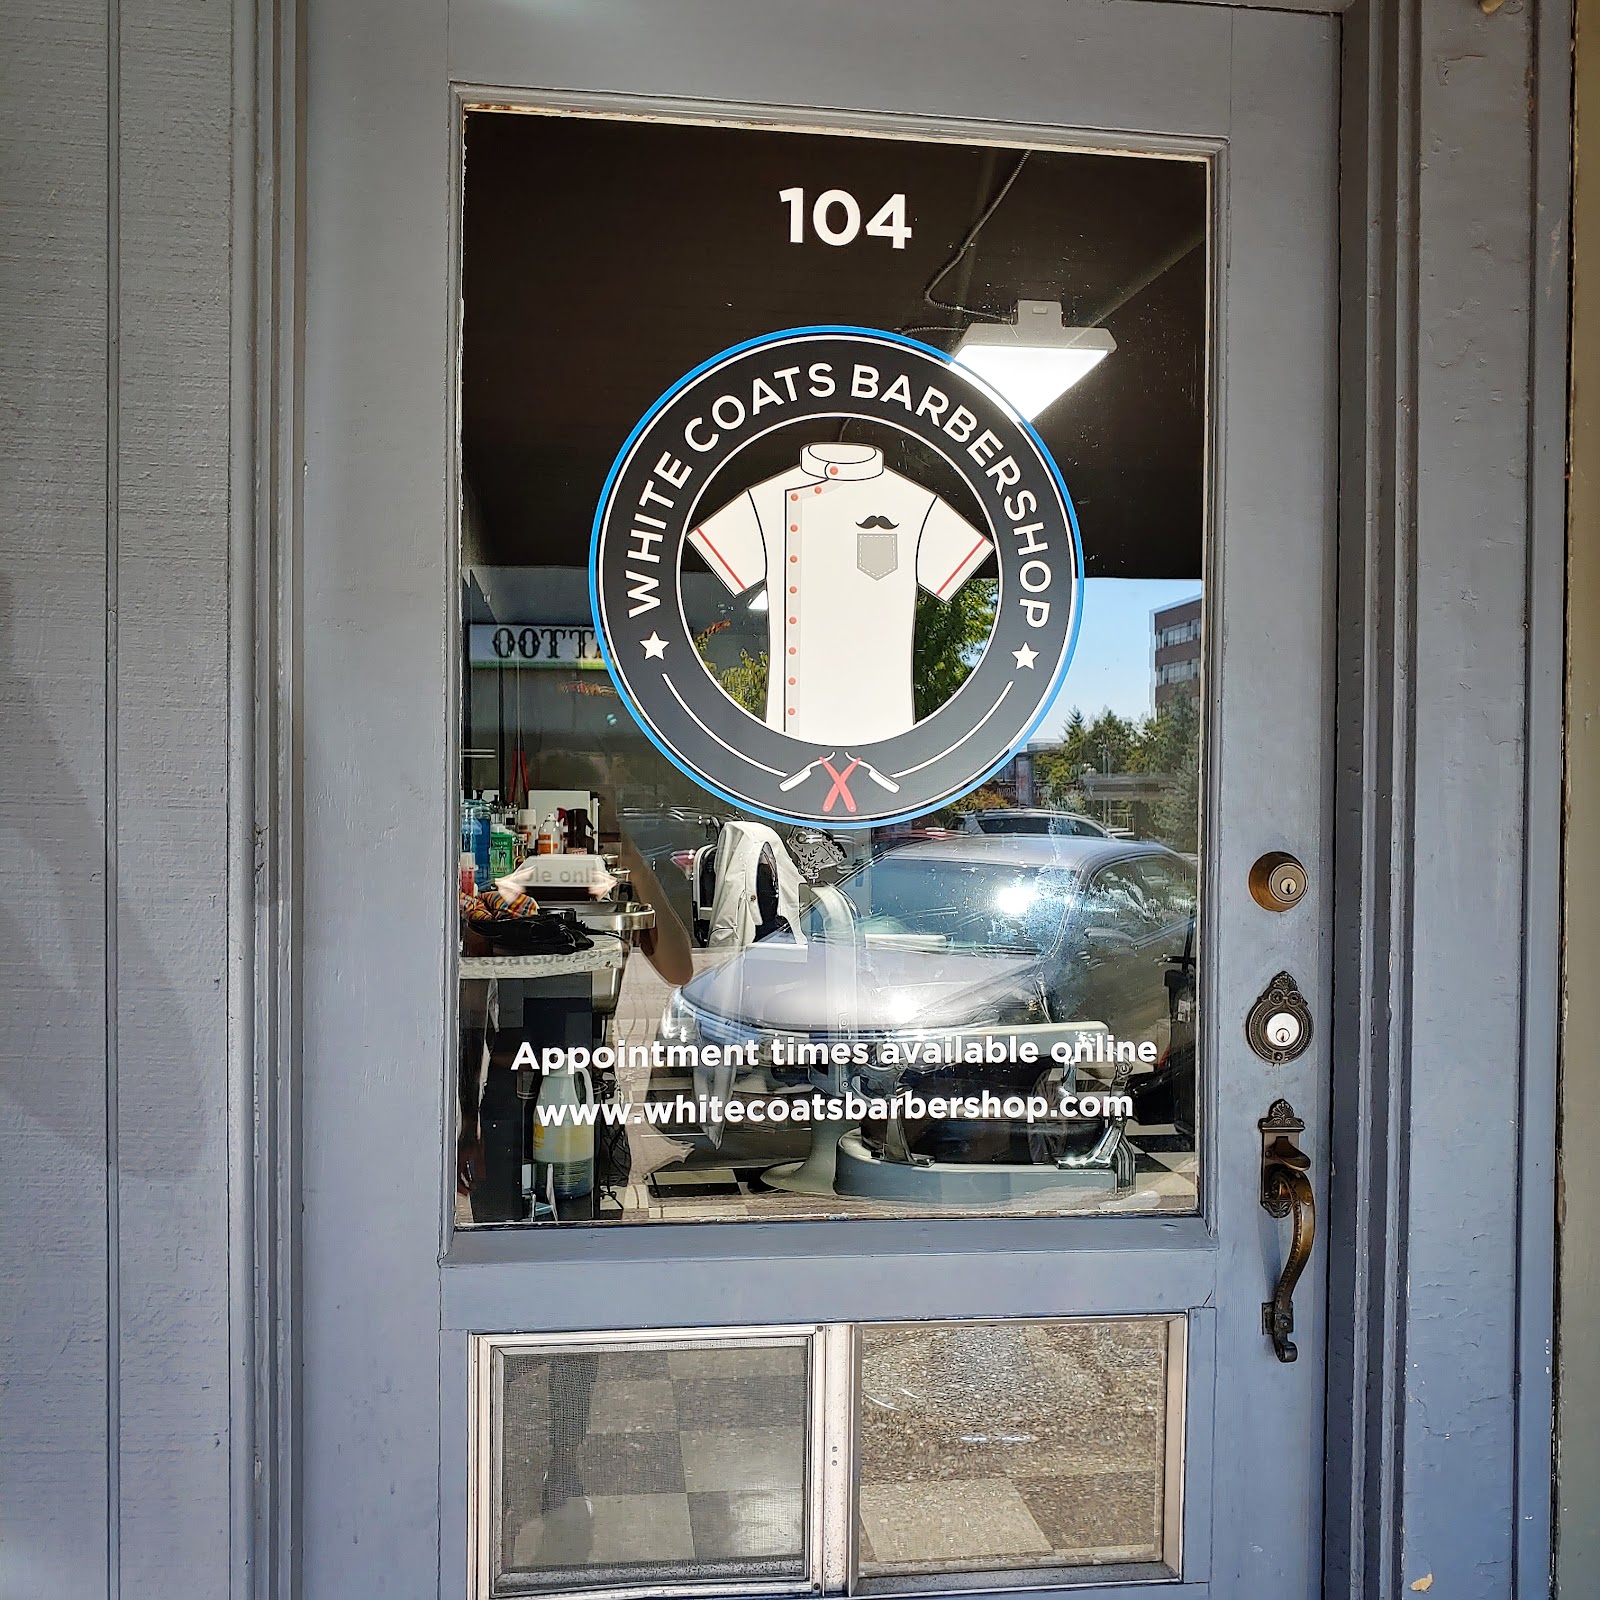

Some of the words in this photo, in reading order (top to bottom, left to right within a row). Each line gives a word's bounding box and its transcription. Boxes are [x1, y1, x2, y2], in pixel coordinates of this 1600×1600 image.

[778, 186, 913, 250] 104
[623, 450, 694, 619] WHITE
[683, 362, 837, 454] COATS
[850, 363, 1052, 629] BARBERSHOP
[510, 1038, 760, 1077] Appointment
[769, 1037, 870, 1067] times
[879, 1034, 1040, 1065] available
[1049, 1033, 1158, 1064] online
[535, 1087, 1135, 1127] www.whitecoatsbarbershop.com
